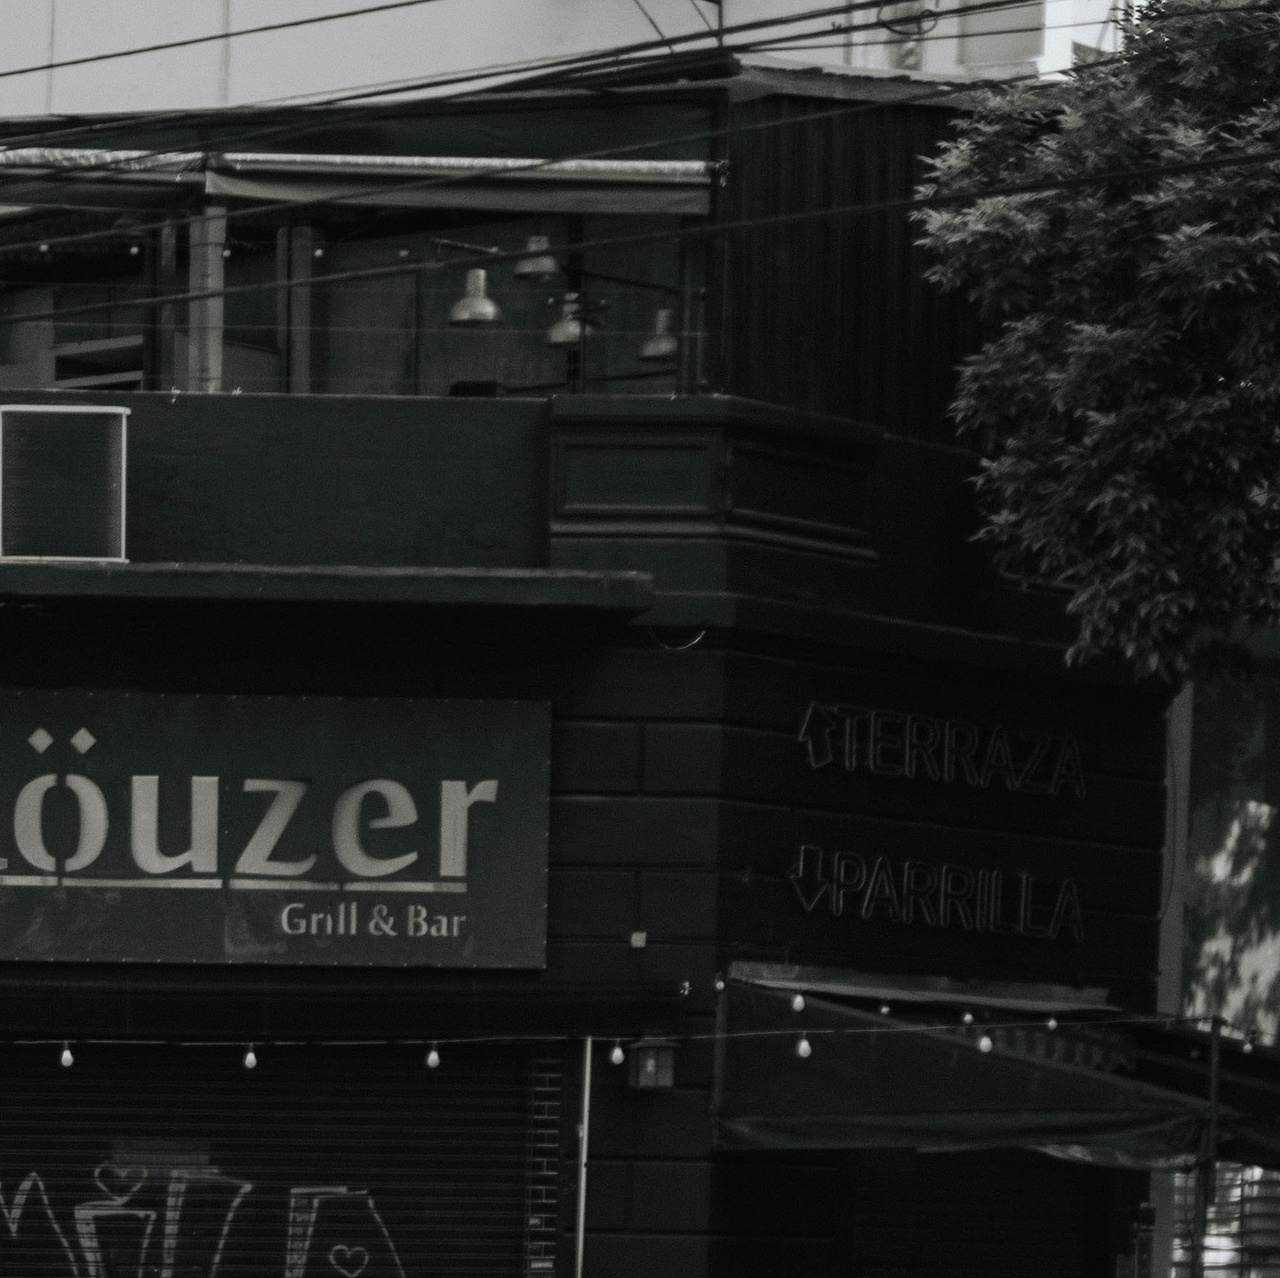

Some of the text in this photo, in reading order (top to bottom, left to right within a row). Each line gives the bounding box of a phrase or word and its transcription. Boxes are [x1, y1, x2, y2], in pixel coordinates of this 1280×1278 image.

[833, 703, 1086, 800] TERRAZA
[281, 901, 467, 937] Grill & Bar
[832, 850, 1085, 943] PARRILLA
